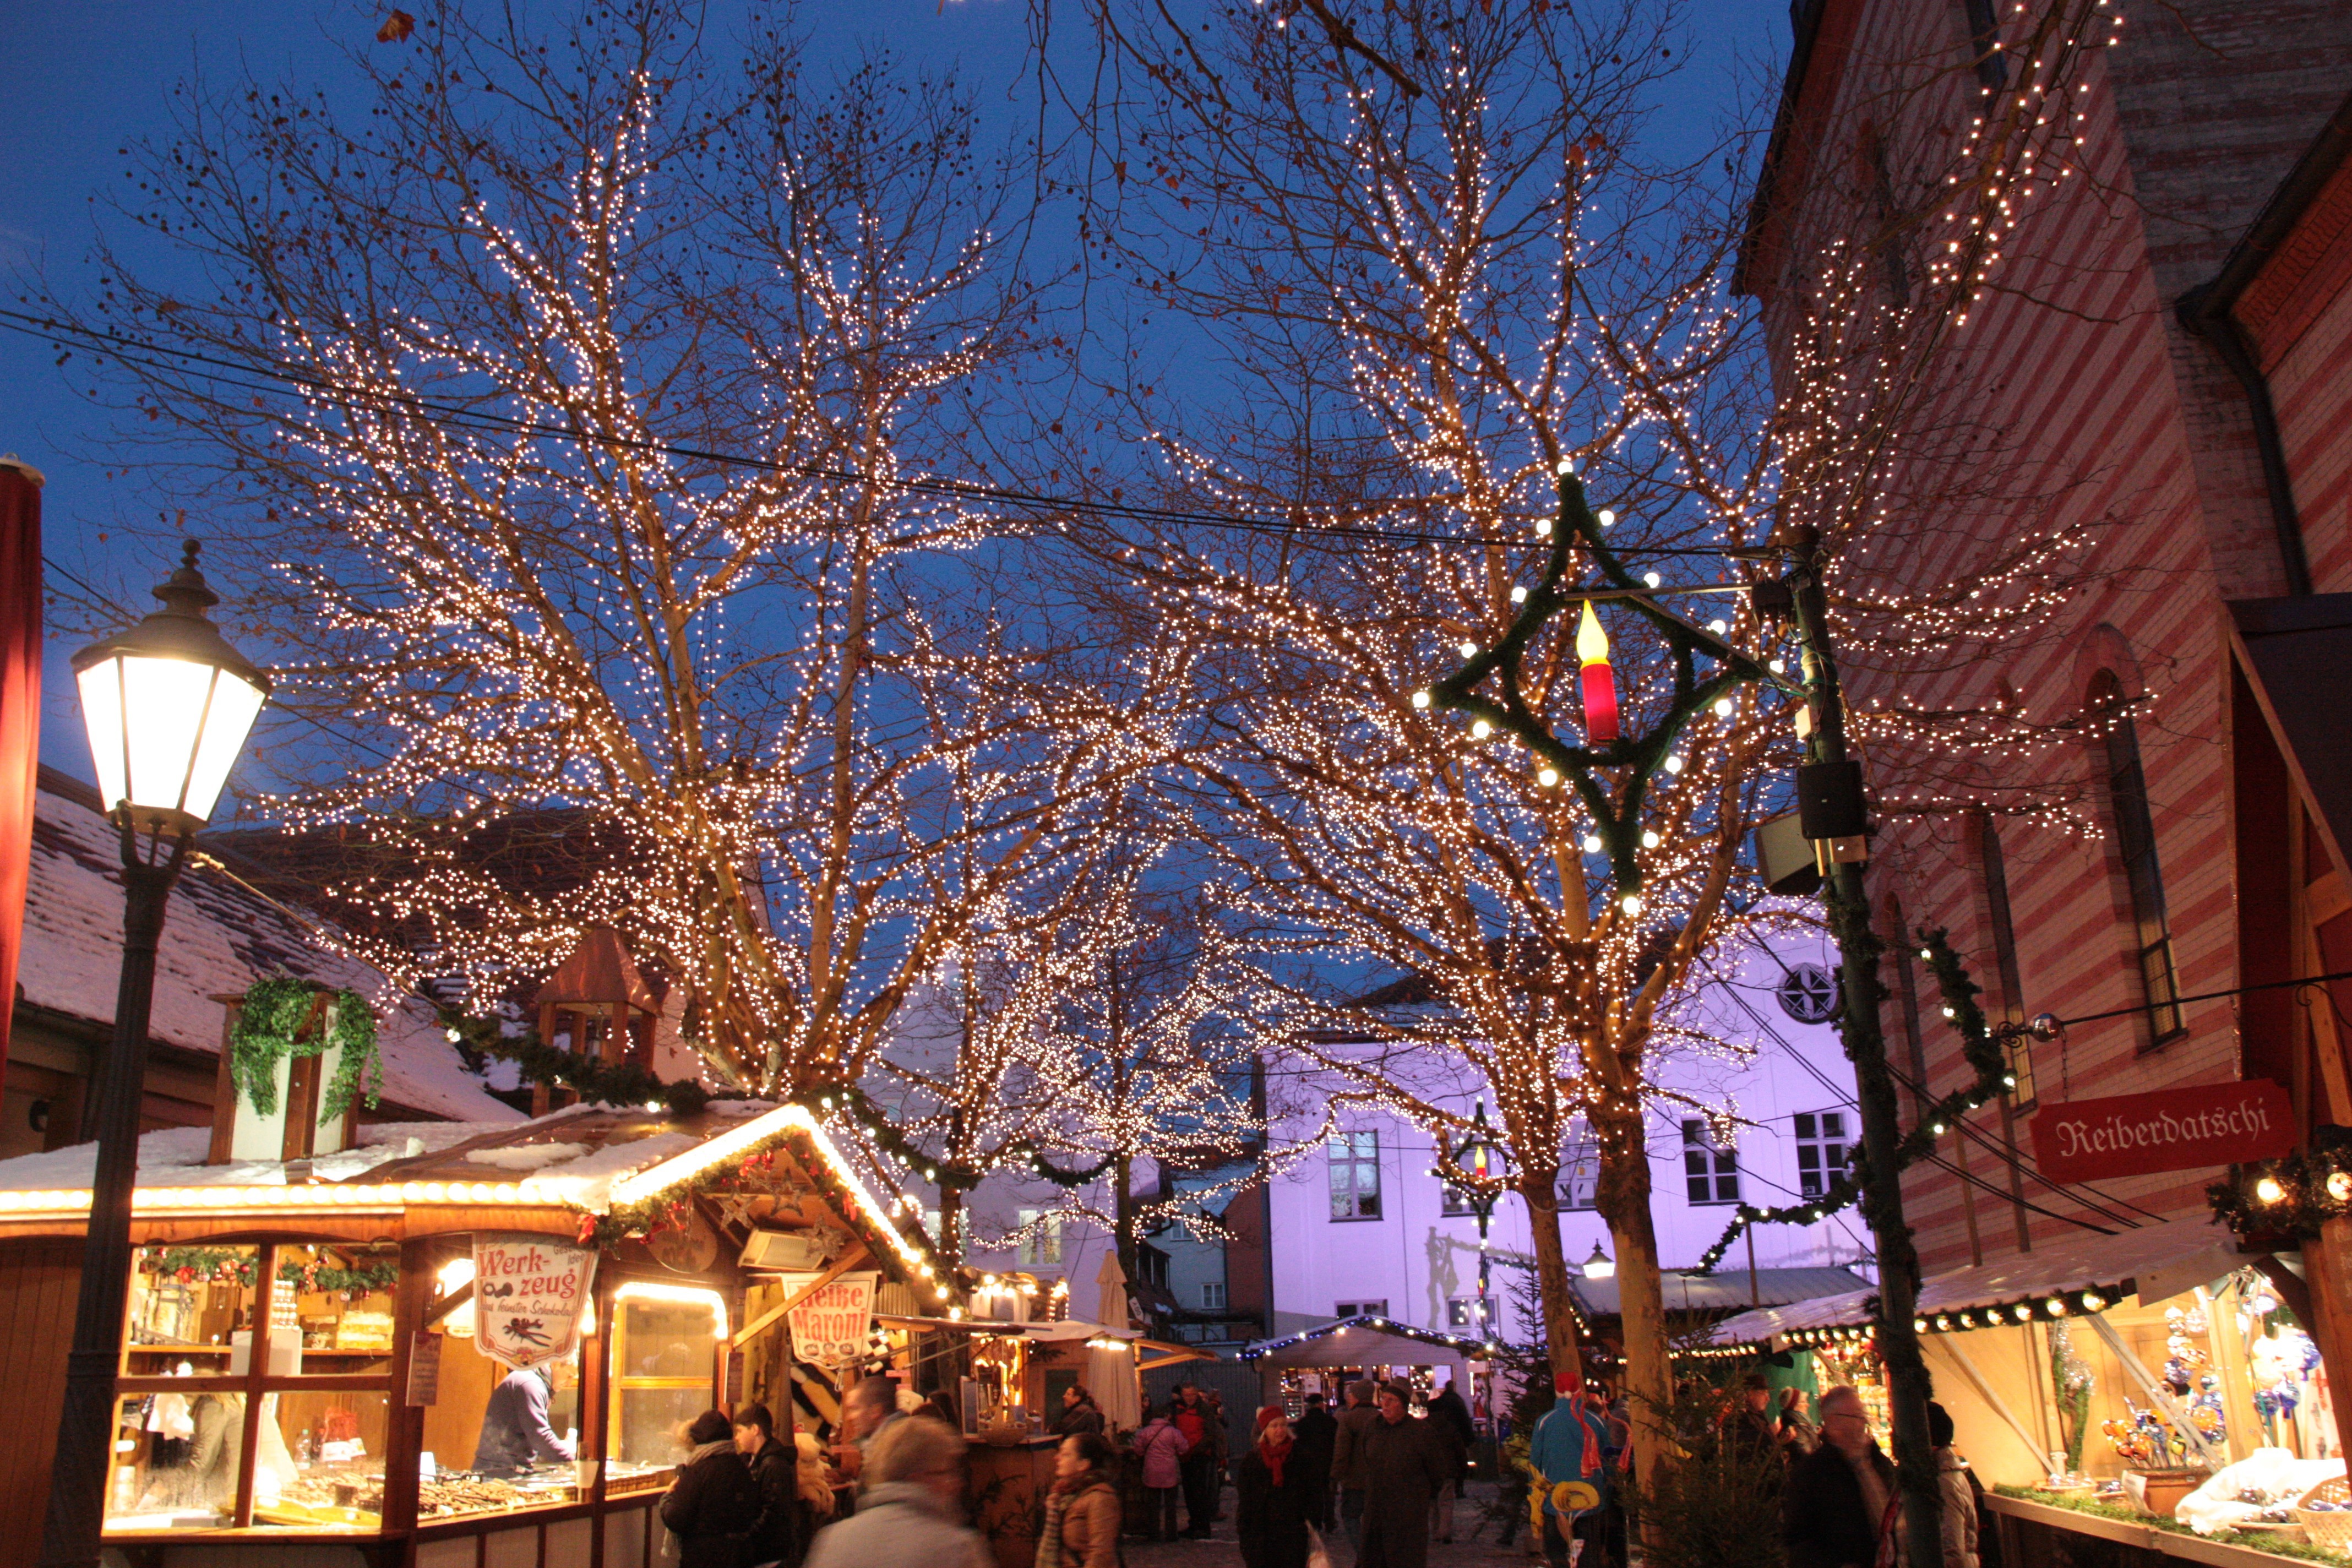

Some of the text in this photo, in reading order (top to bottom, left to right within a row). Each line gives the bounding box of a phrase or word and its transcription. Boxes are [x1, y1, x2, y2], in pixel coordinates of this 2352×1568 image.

[2056, 1097, 2271, 1158] Reiberdatschi
[477, 1246, 550, 1277] Werk-
[520, 1268, 576, 1299] zeug
[793, 1308, 867, 1342] Maroni
